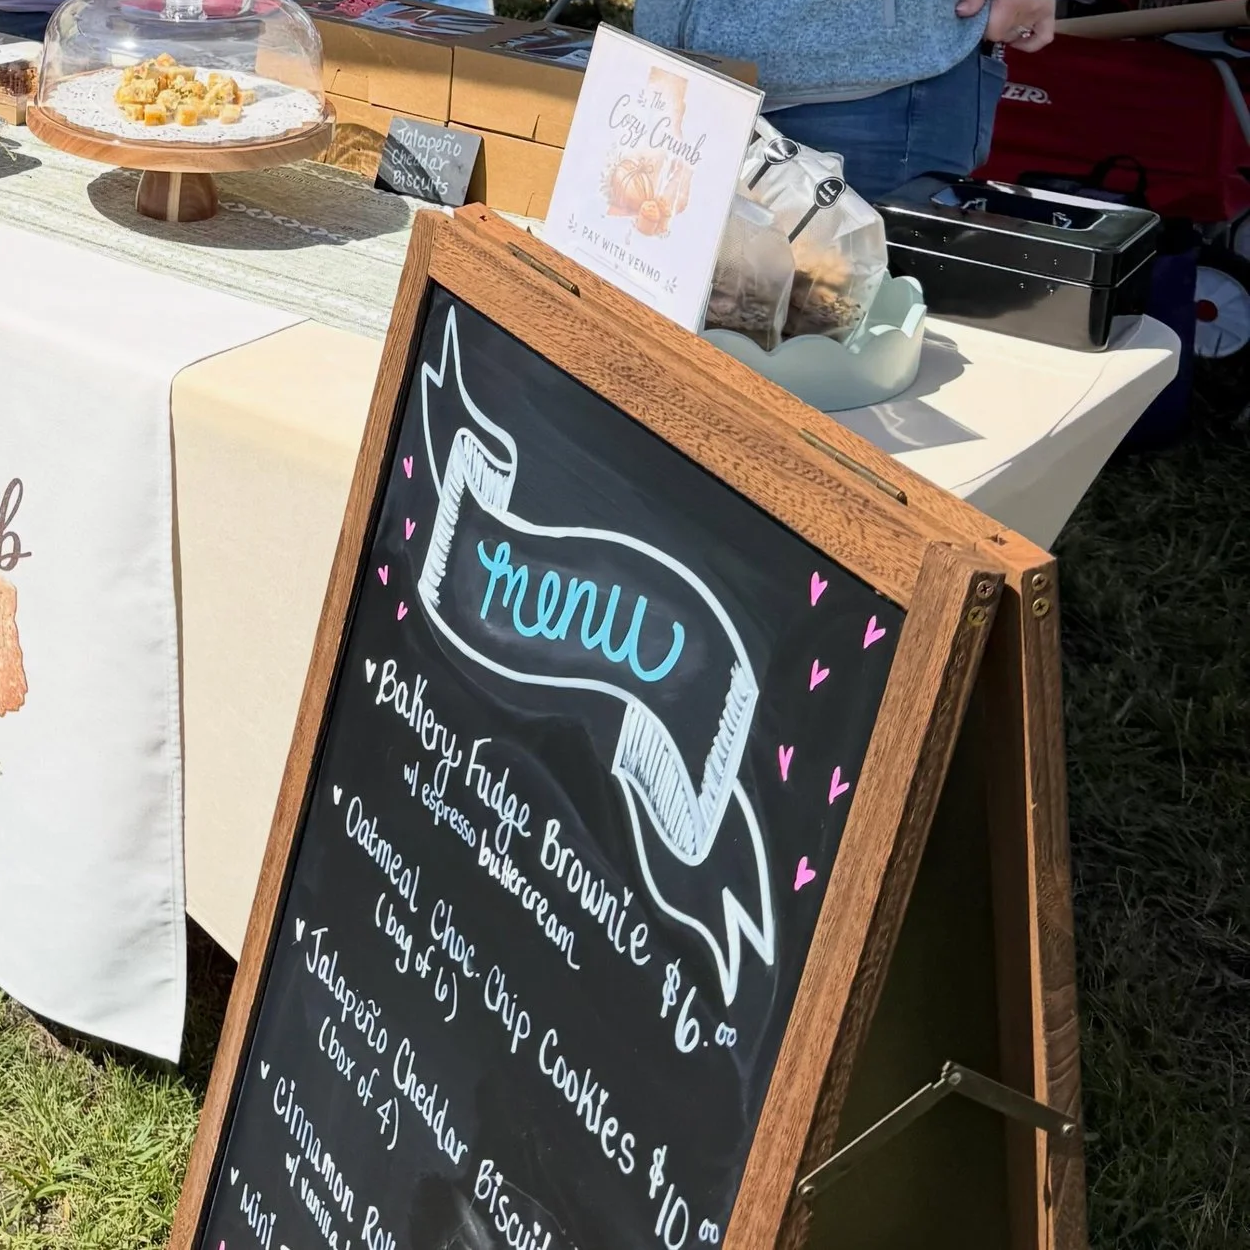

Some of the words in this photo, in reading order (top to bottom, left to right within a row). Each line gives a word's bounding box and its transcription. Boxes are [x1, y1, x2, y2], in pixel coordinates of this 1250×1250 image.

[397, 118, 462, 157] Jalapeño
[608, 93, 648, 149] Cozy
[649, 116, 707, 166] Crumb
[650, 91, 666, 111] The
[392, 169, 449, 196] Biscuits
[581, 225, 599, 244] PAY
[602, 238, 626, 261] WITH
[628, 252, 661, 283] VENMO
[421, 782, 477, 848] espresso
[477, 828, 581, 971] buttercream
[465, 737, 532, 855] Fudge
[540, 818, 651, 966] Brownie
[346, 795, 420, 913] Oatmeal
[483, 965, 531, 1054] Chip
[538, 1028, 636, 1175] Cookies
[375, 892, 413, 974] (bag
[415, 945, 435, 979] of
[434, 966, 459, 1023] 6)
[305, 926, 389, 1055] Jalapeño
[393, 1037, 469, 1166] Cheddar
[318, 1016, 357, 1081] (box
[357, 1068, 380, 1107] of
[377, 1096, 400, 1150] 4)
[273, 1076, 354, 1223] Cinnamon
[301, 1176, 338, 1247] vanilla
